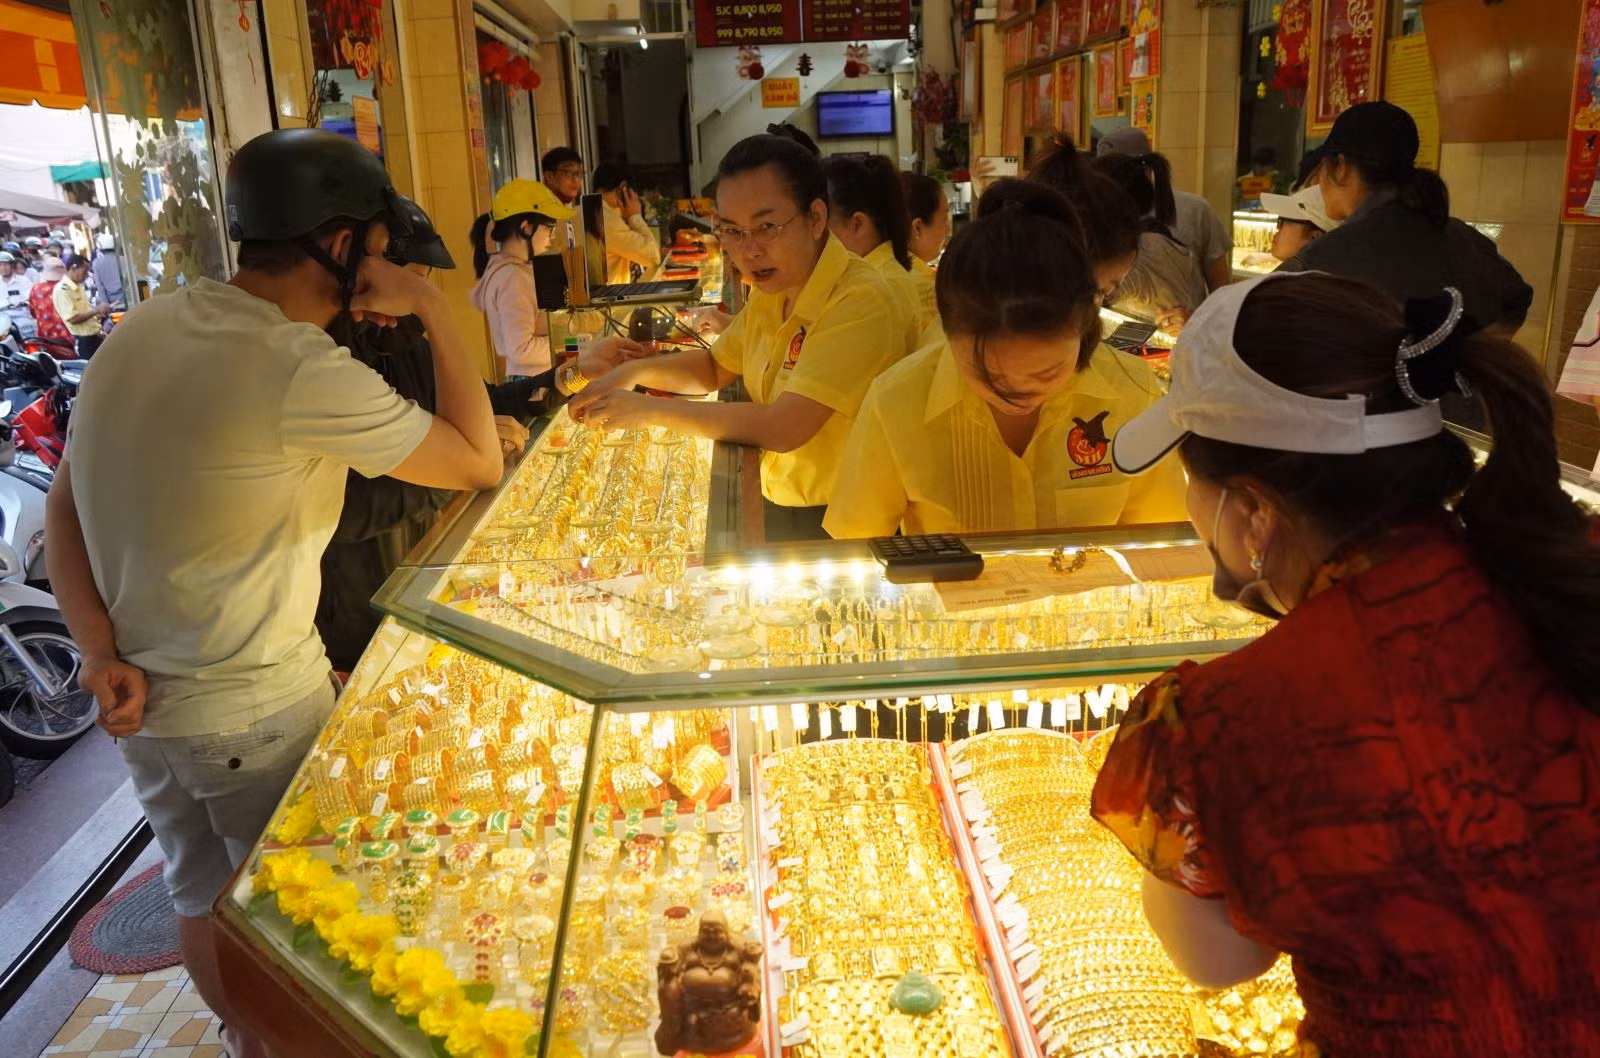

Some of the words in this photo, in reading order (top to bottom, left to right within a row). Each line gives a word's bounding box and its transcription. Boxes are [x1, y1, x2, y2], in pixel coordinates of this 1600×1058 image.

[715, 5, 732, 15] SJC
[758, 3, 783, 14] 8,950
[716, 28, 733, 38] 999
[759, 26, 783, 37] 8,950
